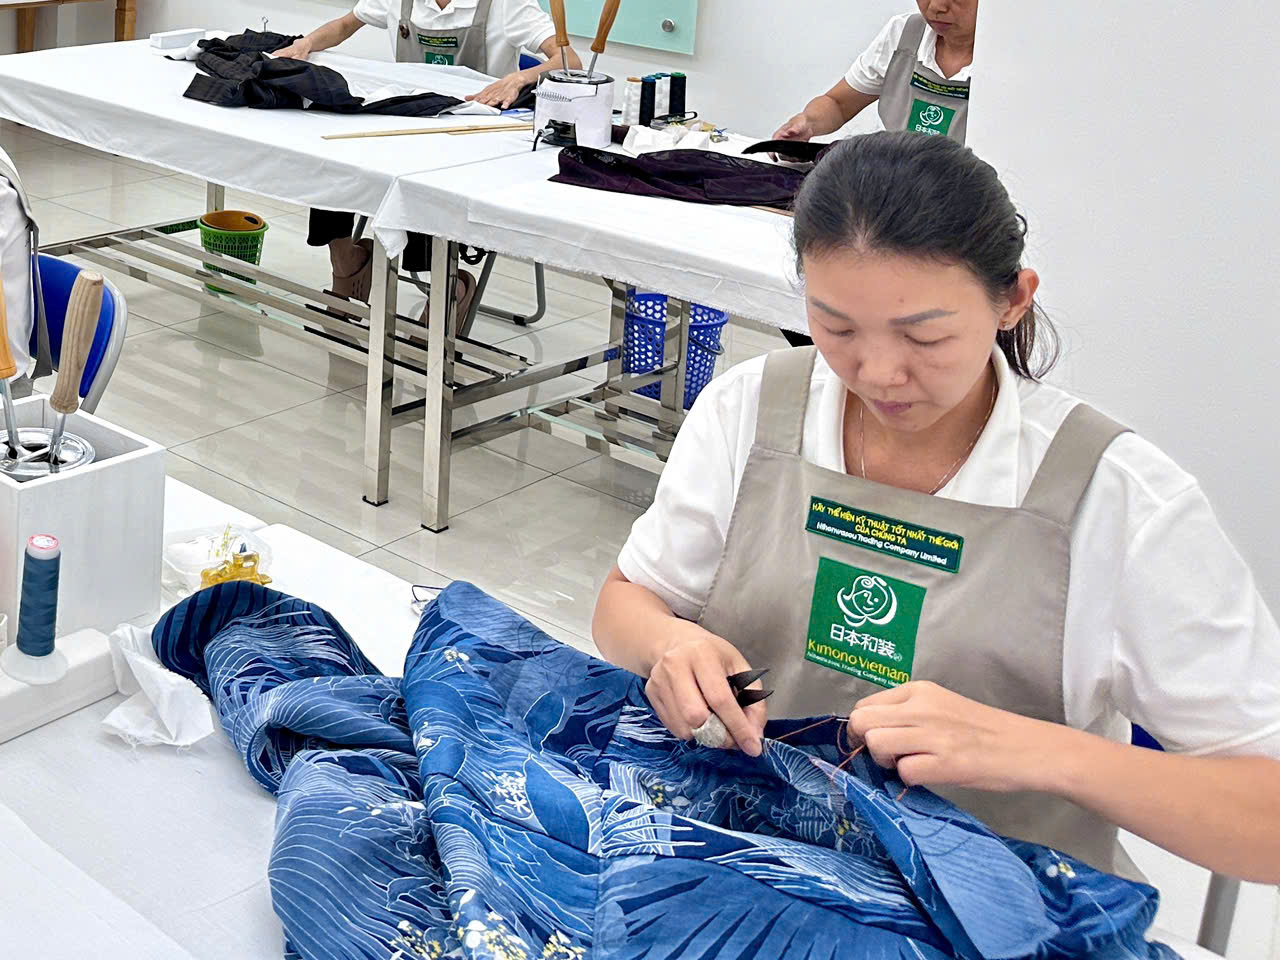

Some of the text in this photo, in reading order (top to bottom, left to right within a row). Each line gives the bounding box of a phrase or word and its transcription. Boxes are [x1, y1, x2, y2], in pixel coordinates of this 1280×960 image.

[812, 503, 825, 513] HÃY
[891, 525, 906, 536] TỐT
[906, 530, 926, 541] NHẤT
[897, 535, 907, 545] TA
[856, 534, 883, 548] Trading
[884, 541, 920, 558] Company
[920, 551, 948, 565] Limited
[830, 623, 896, 659] 日本和装
[808, 638, 910, 683] Kimono Vietnam
